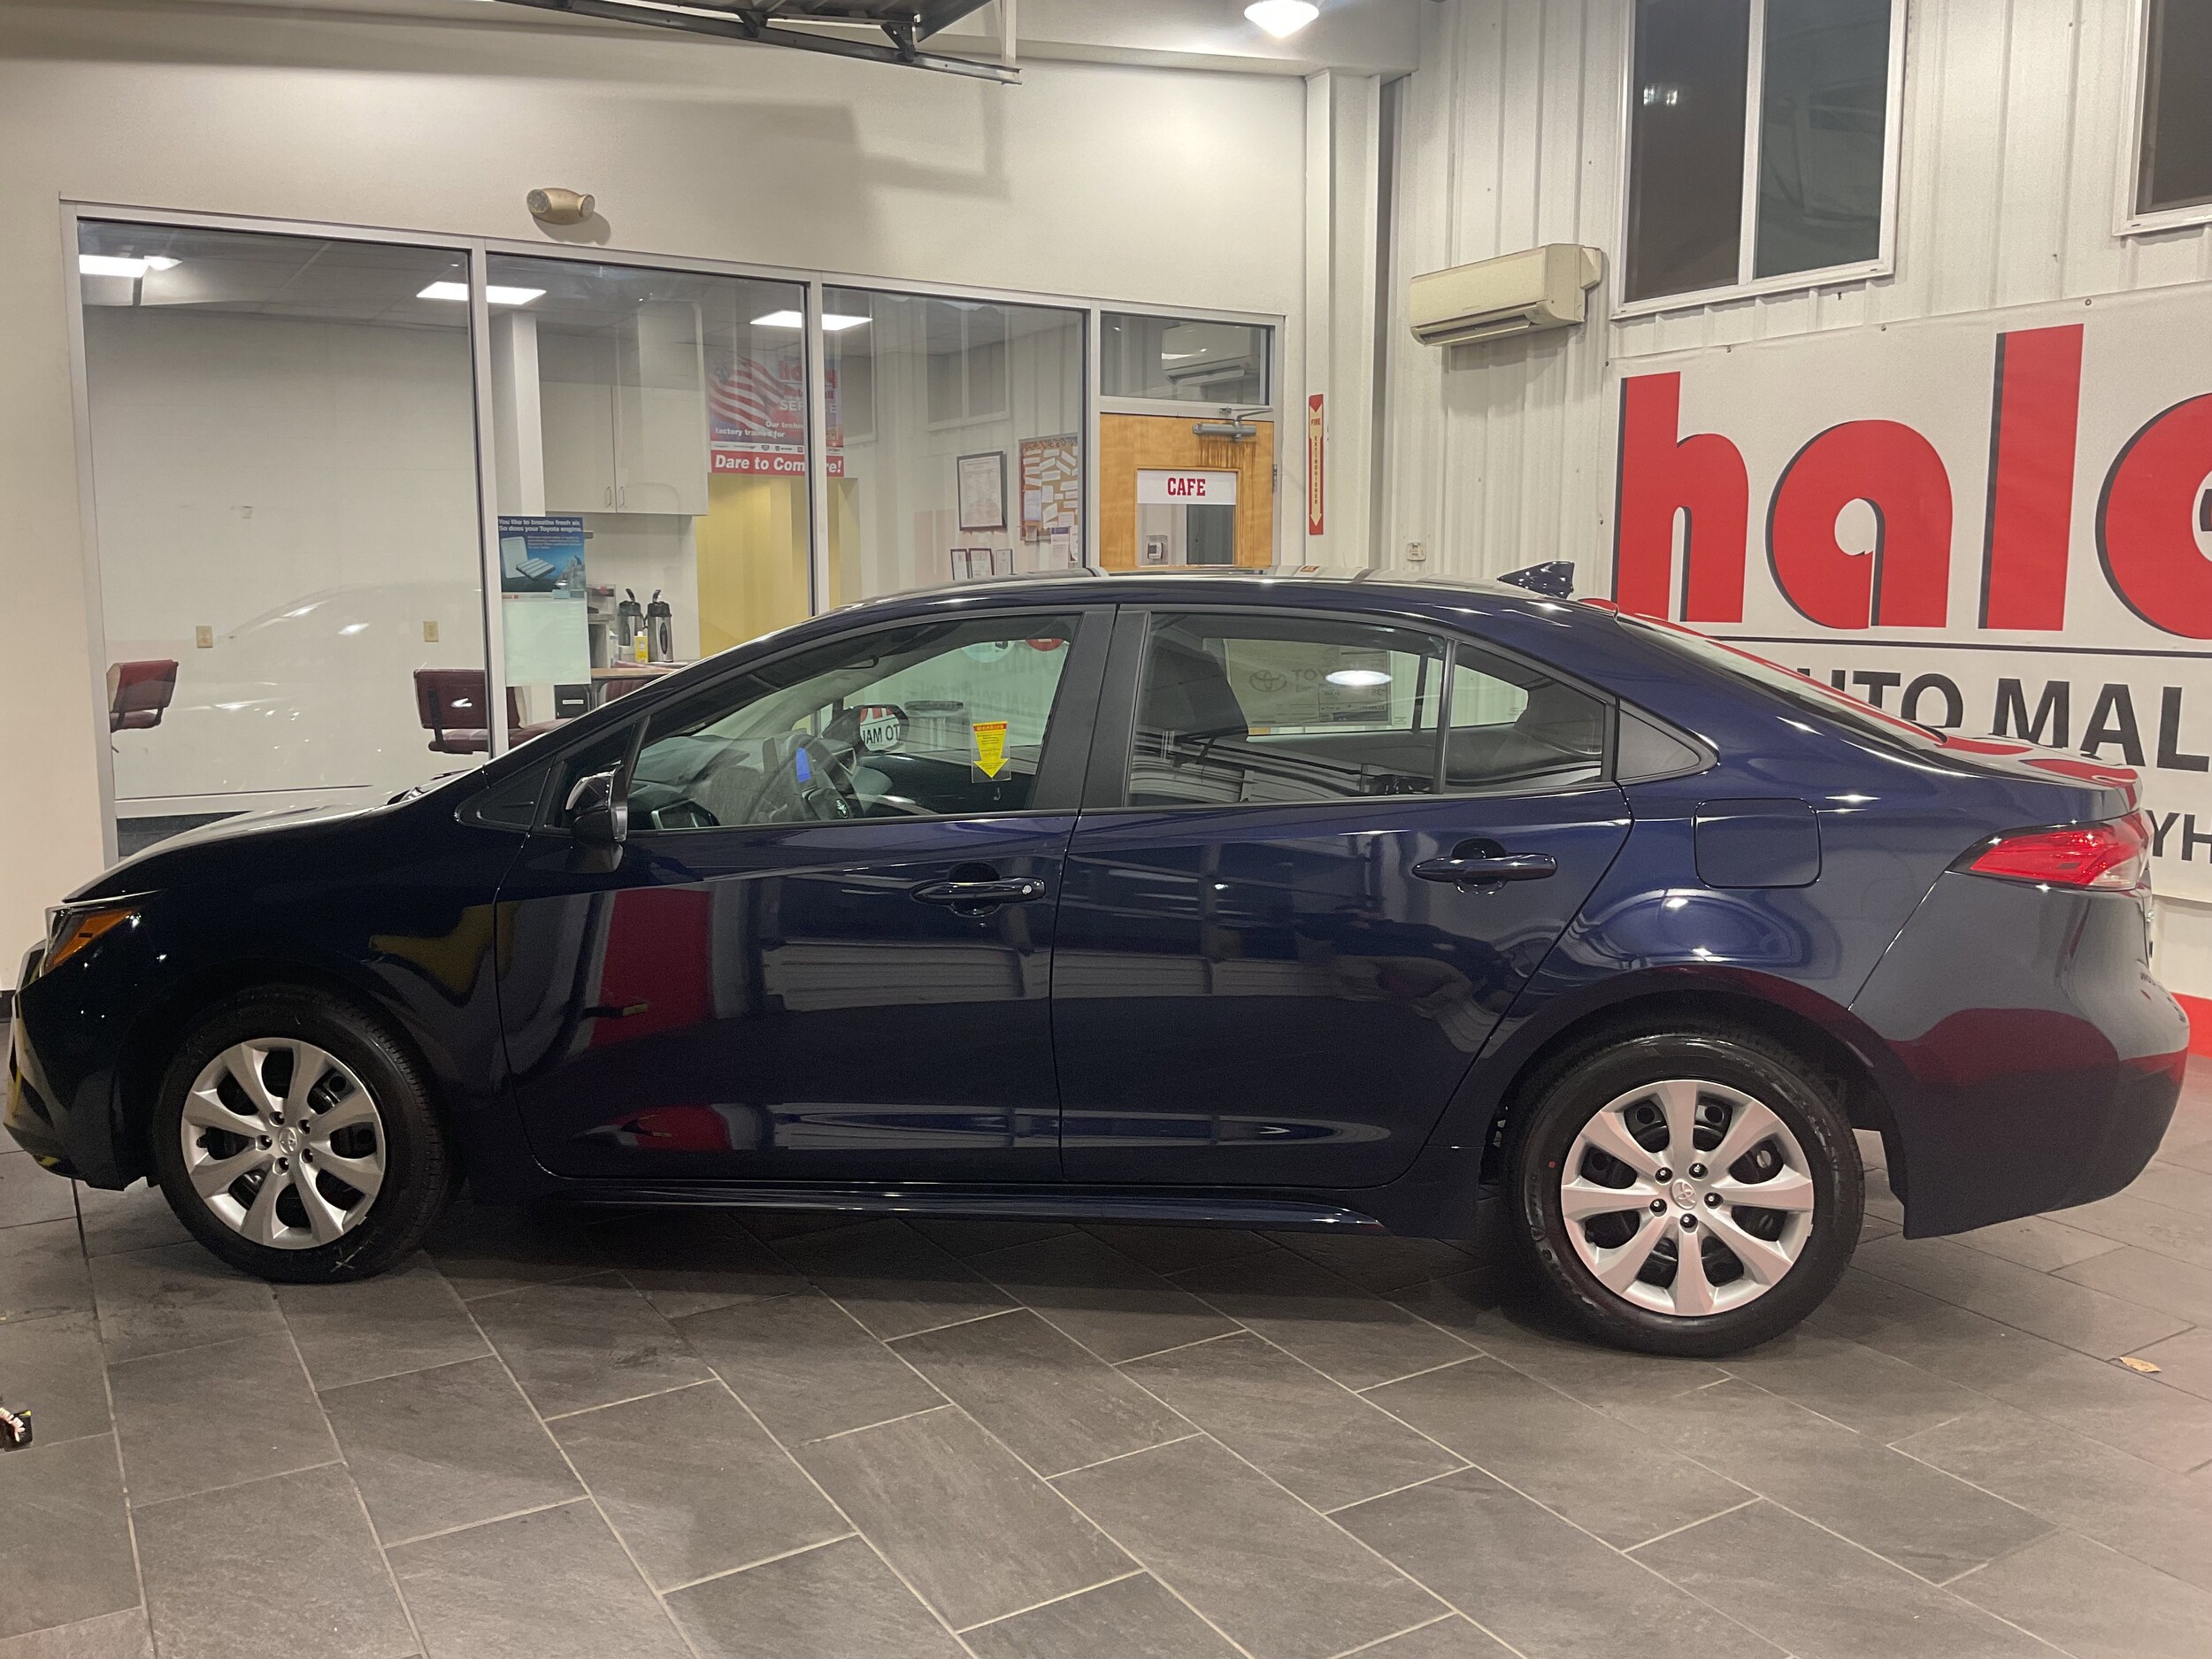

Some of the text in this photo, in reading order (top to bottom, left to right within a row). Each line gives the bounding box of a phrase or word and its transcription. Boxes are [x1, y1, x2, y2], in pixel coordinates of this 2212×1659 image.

[715, 427, 742, 437] factory
[744, 428, 772, 437] trained
[774, 430, 786, 439] for
[715, 454, 750, 469] Dare
[754, 457, 770, 470] to
[1167, 477, 1206, 496] CAFE
[1797, 668, 1963, 728] TO
